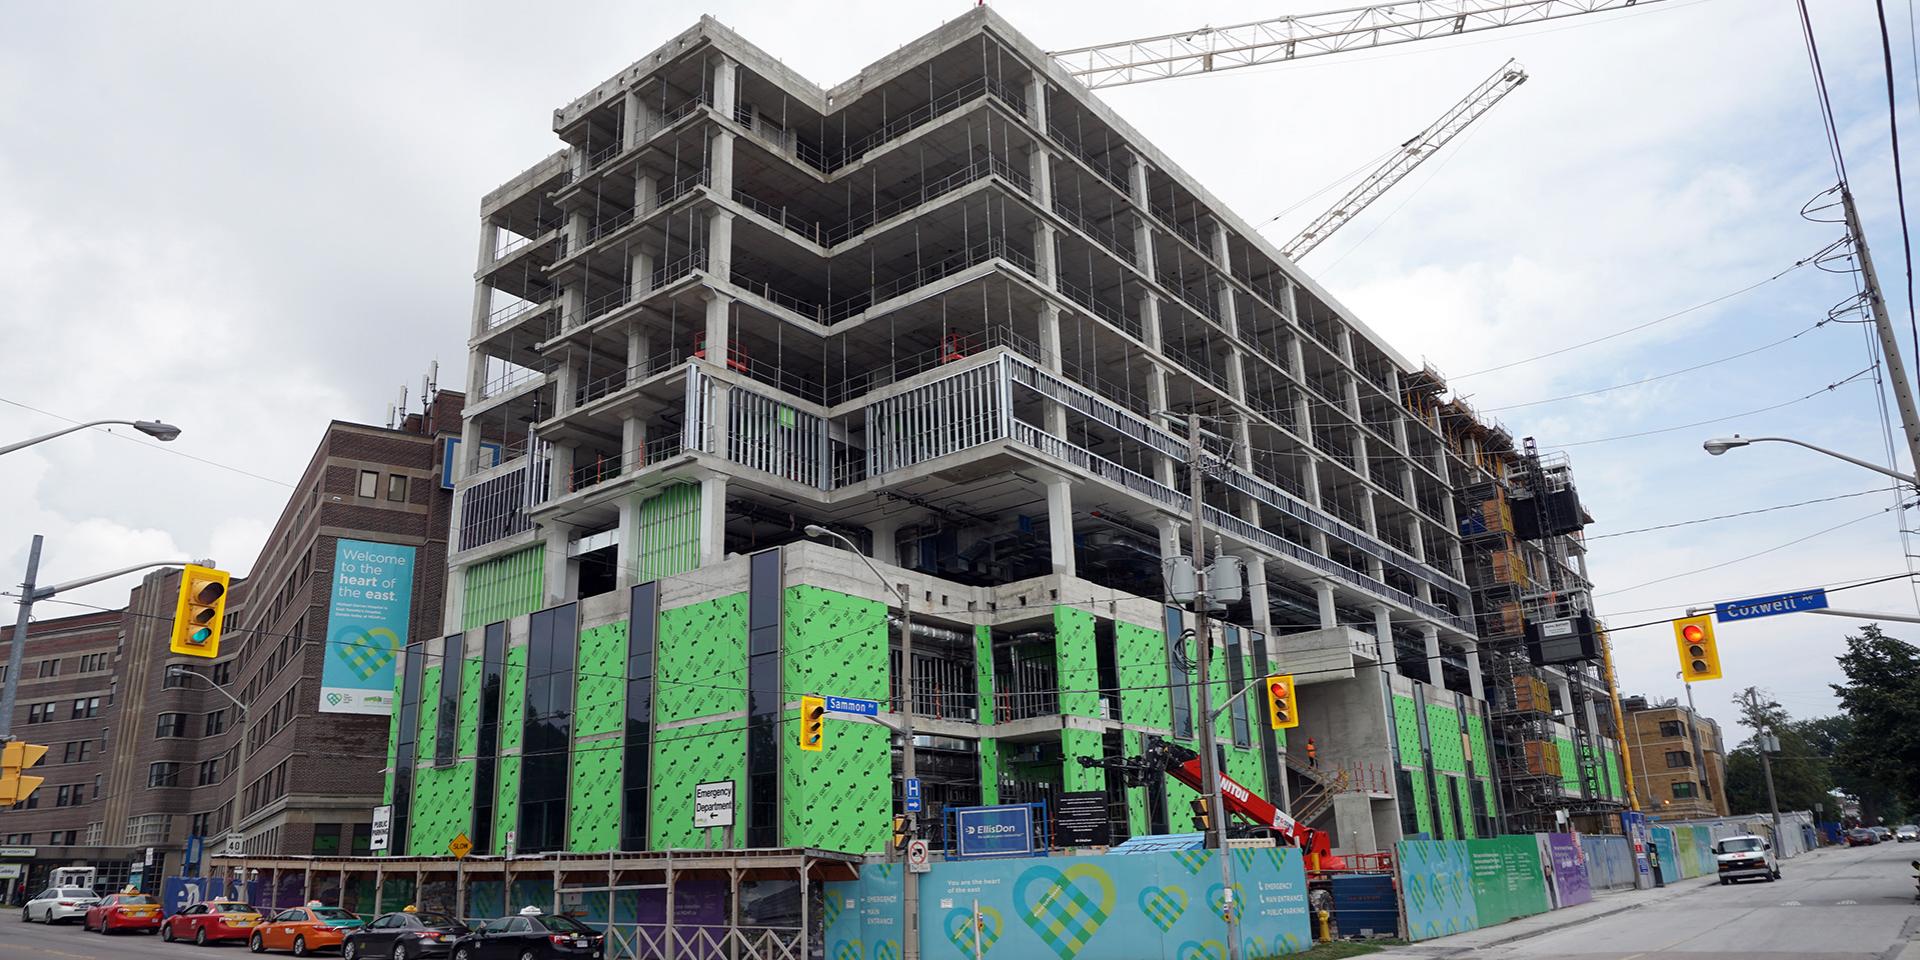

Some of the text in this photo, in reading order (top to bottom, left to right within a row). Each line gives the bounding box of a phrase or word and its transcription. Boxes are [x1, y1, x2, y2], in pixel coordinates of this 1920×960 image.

[343, 548, 405, 566] Welcome
[342, 562, 382, 575] to the
[340, 573, 397, 589] heart of
[339, 586, 398, 602] the east.
[1727, 596, 1797, 617] Coxwell
[830, 698, 866, 712] Sammon
[696, 788, 732, 799] Emergency
[908, 780, 919, 797] H
[1219, 775, 1250, 803] NITOU
[696, 802, 732, 813] Department
[374, 820, 388, 829] PUBLIC
[977, 824, 1016, 834] EllisDon
[229, 842, 240, 851] 40
